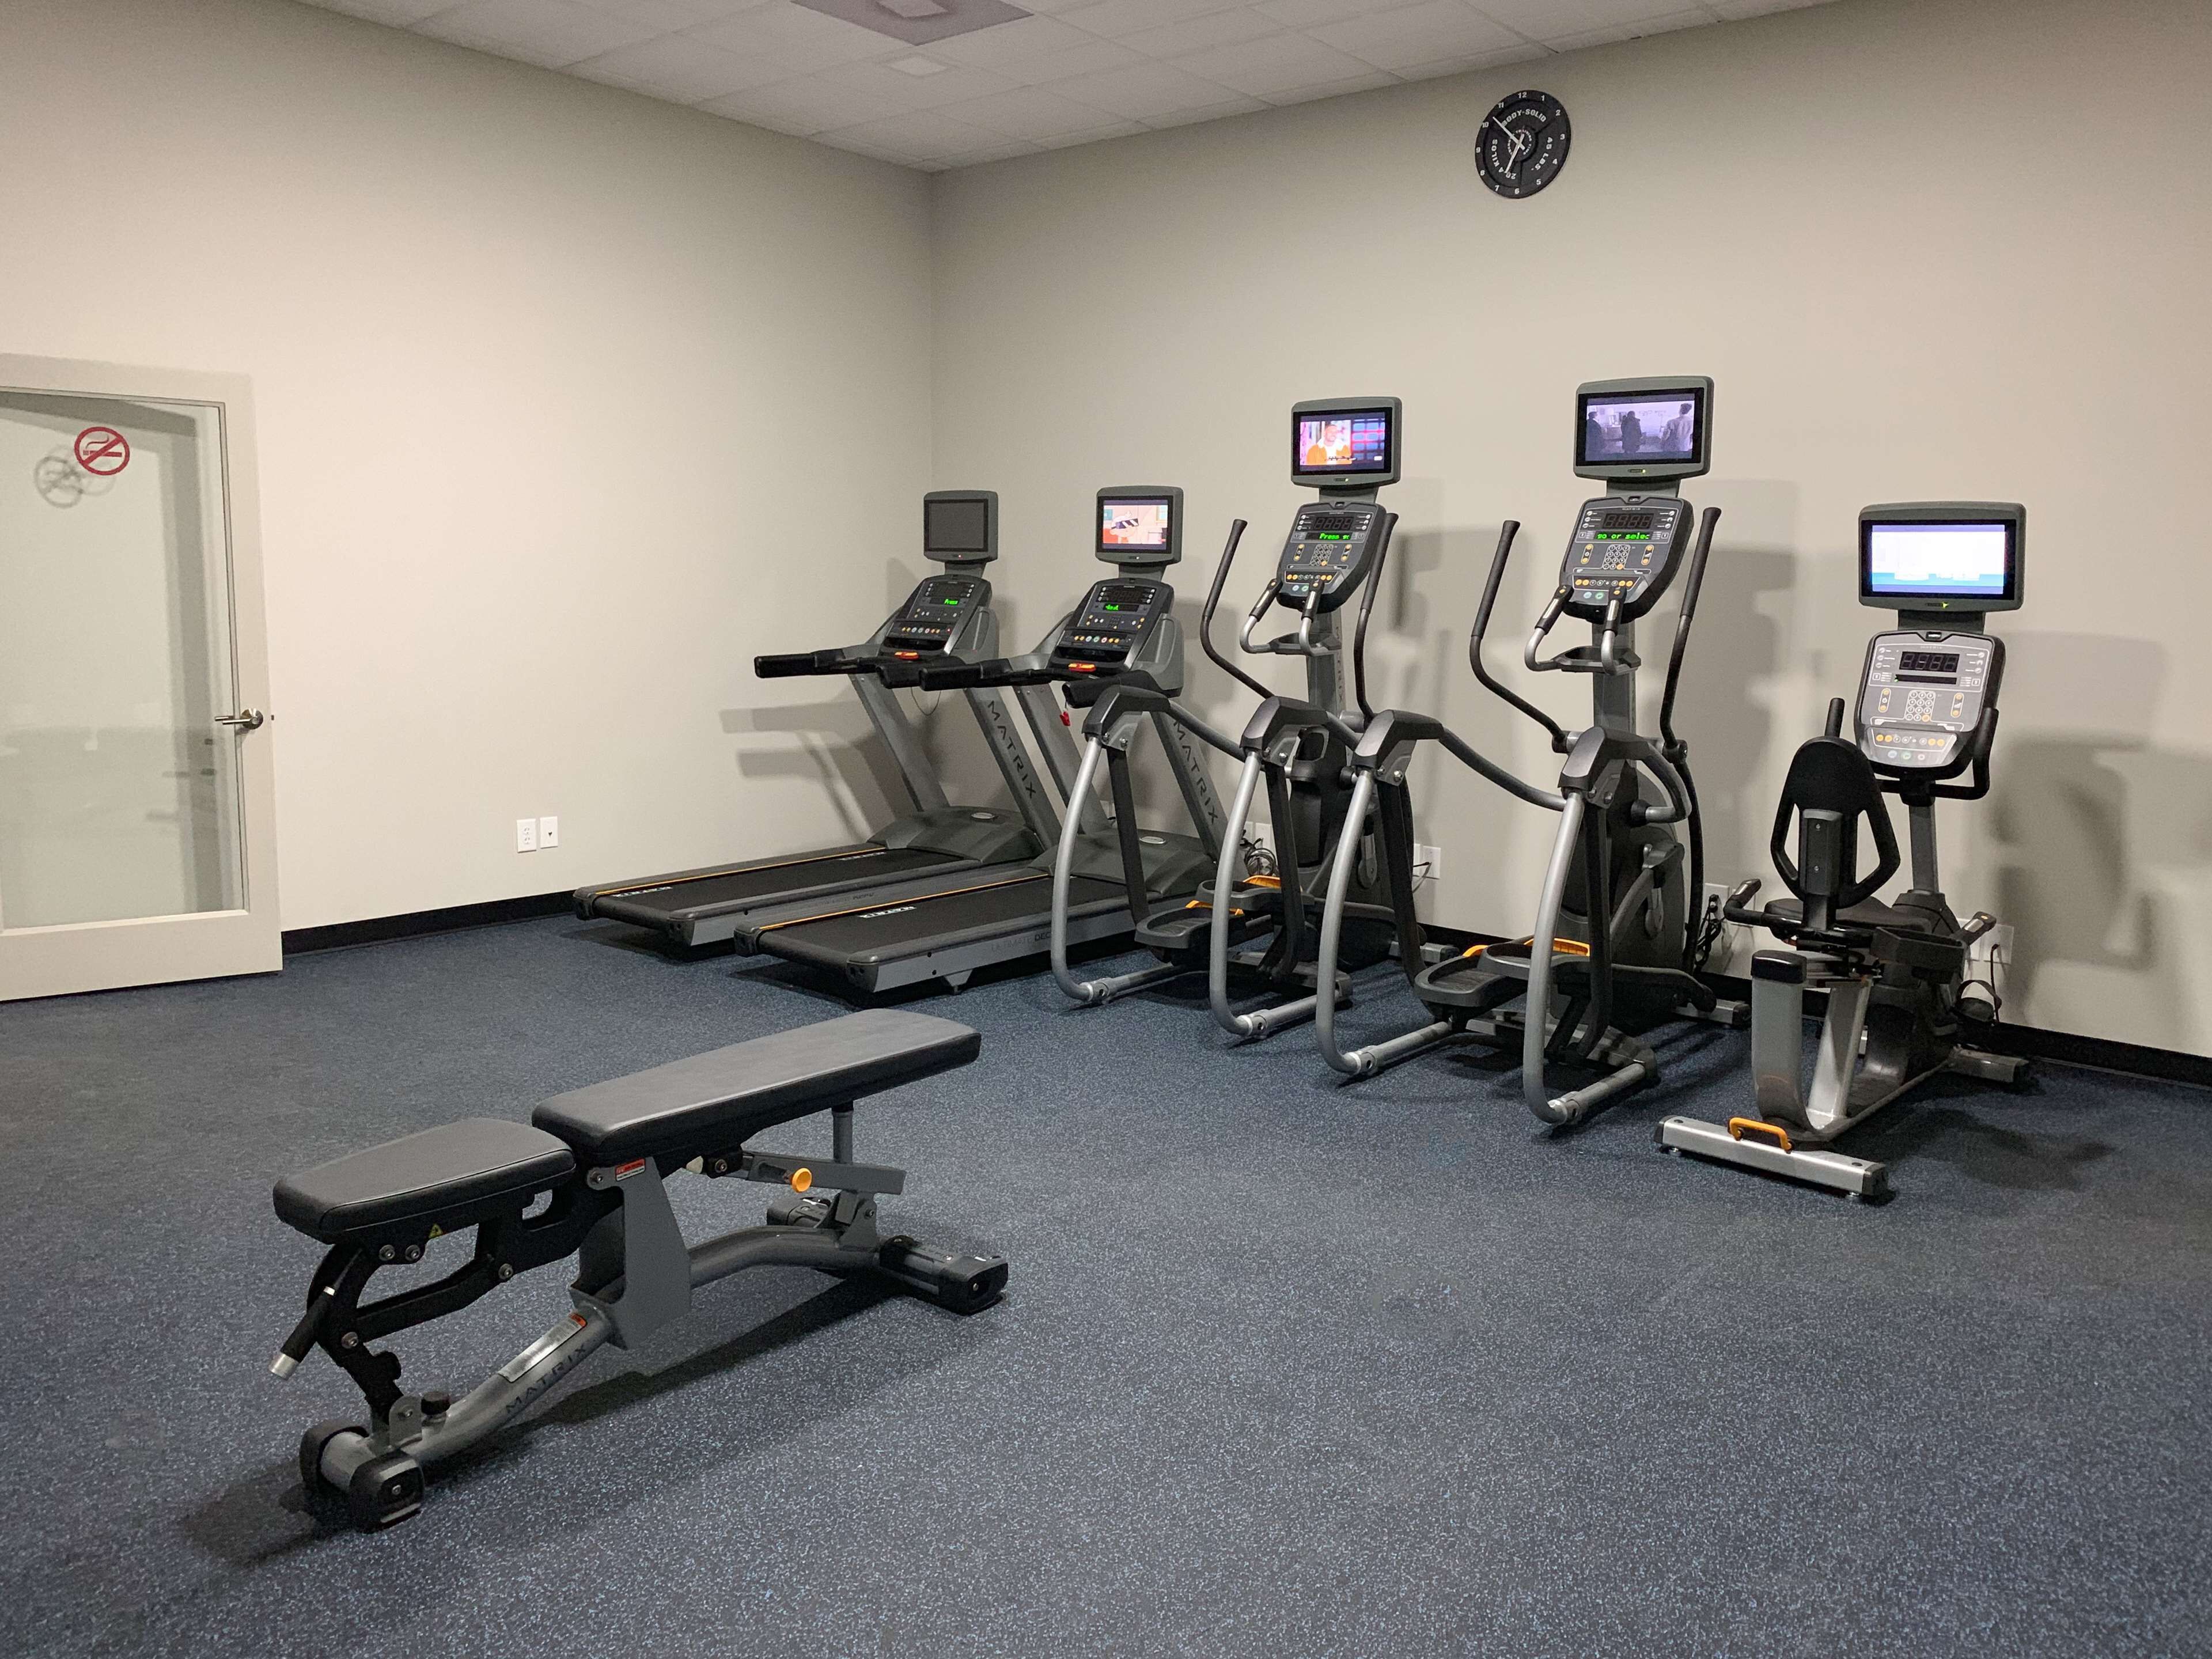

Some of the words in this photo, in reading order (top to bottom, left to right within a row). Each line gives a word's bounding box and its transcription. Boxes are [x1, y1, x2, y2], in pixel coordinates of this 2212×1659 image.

[1501, 108, 1547, 127] BODY-SOLID
[1491, 139, 1500, 167] KILOS
[1546, 137, 1553, 149] 45
[987, 700, 1036, 798] MATRIX
[1173, 719, 1218, 824] MATRIX
[1035, 932, 1052, 942] DEC
[506, 1344, 586, 1414] MATRIX
